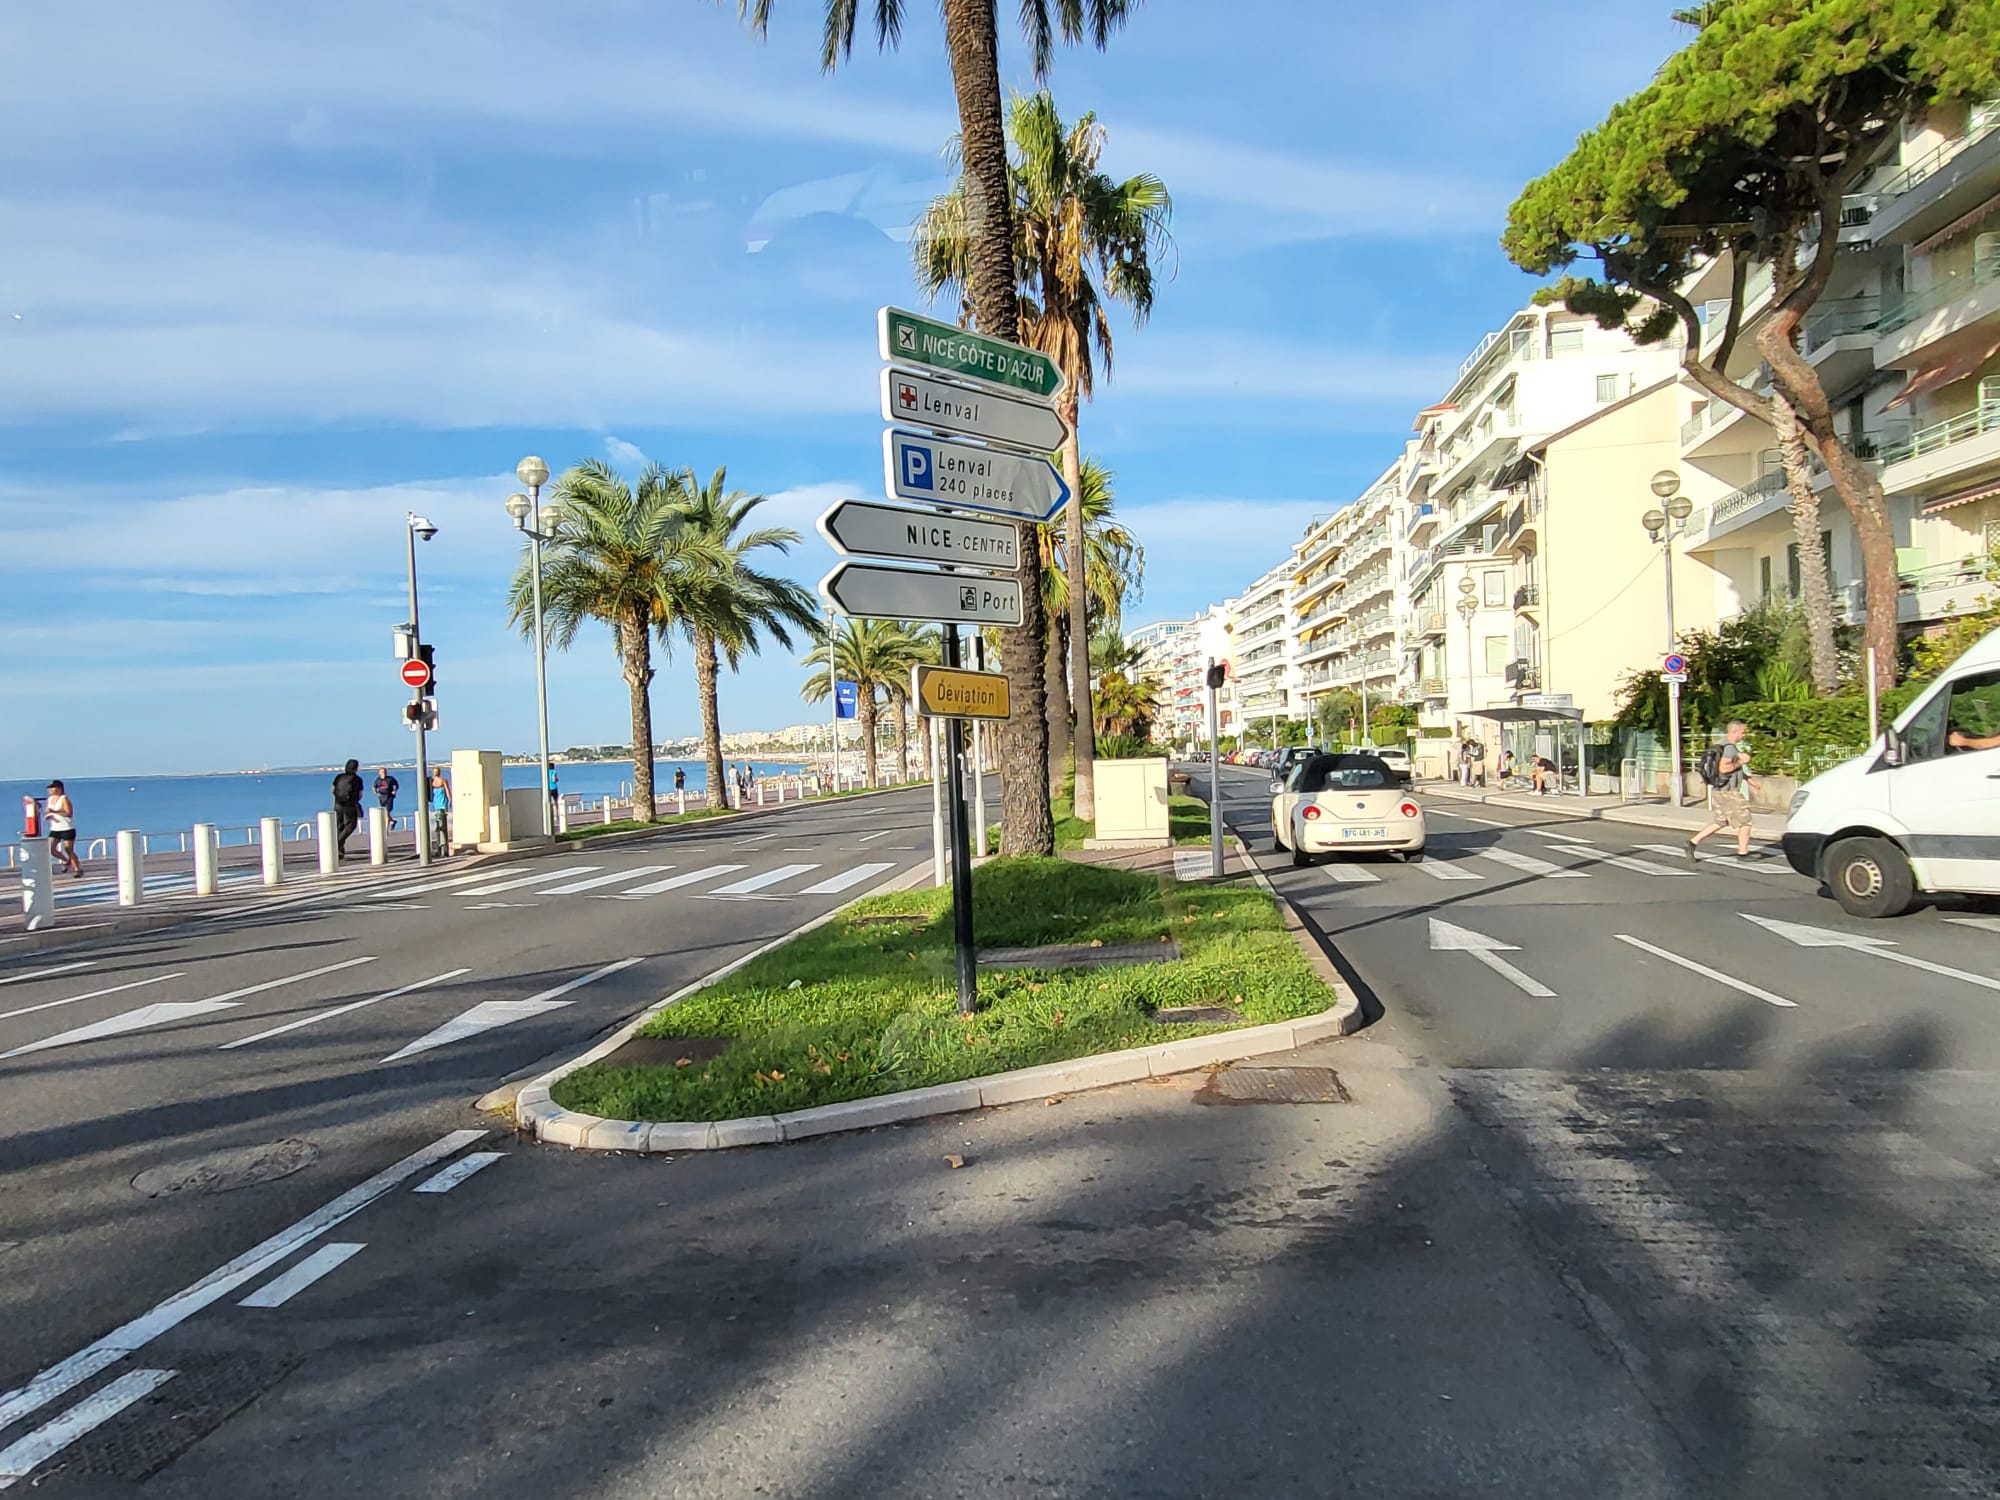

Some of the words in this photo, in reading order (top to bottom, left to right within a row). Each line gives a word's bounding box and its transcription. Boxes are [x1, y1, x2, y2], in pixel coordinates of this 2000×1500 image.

[922, 333, 955, 360] NICE
[958, 343, 994, 371] CÔTE
[924, 392, 979, 421] Lenval
[906, 450, 927, 484] P
[938, 451, 992, 477] Lenval
[939, 476, 966, 495] 240
[973, 484, 1014, 502] places
[906, 524, 952, 548] NICE
[983, 591, 1015, 611] Port
[937, 682, 995, 705] Déviation
